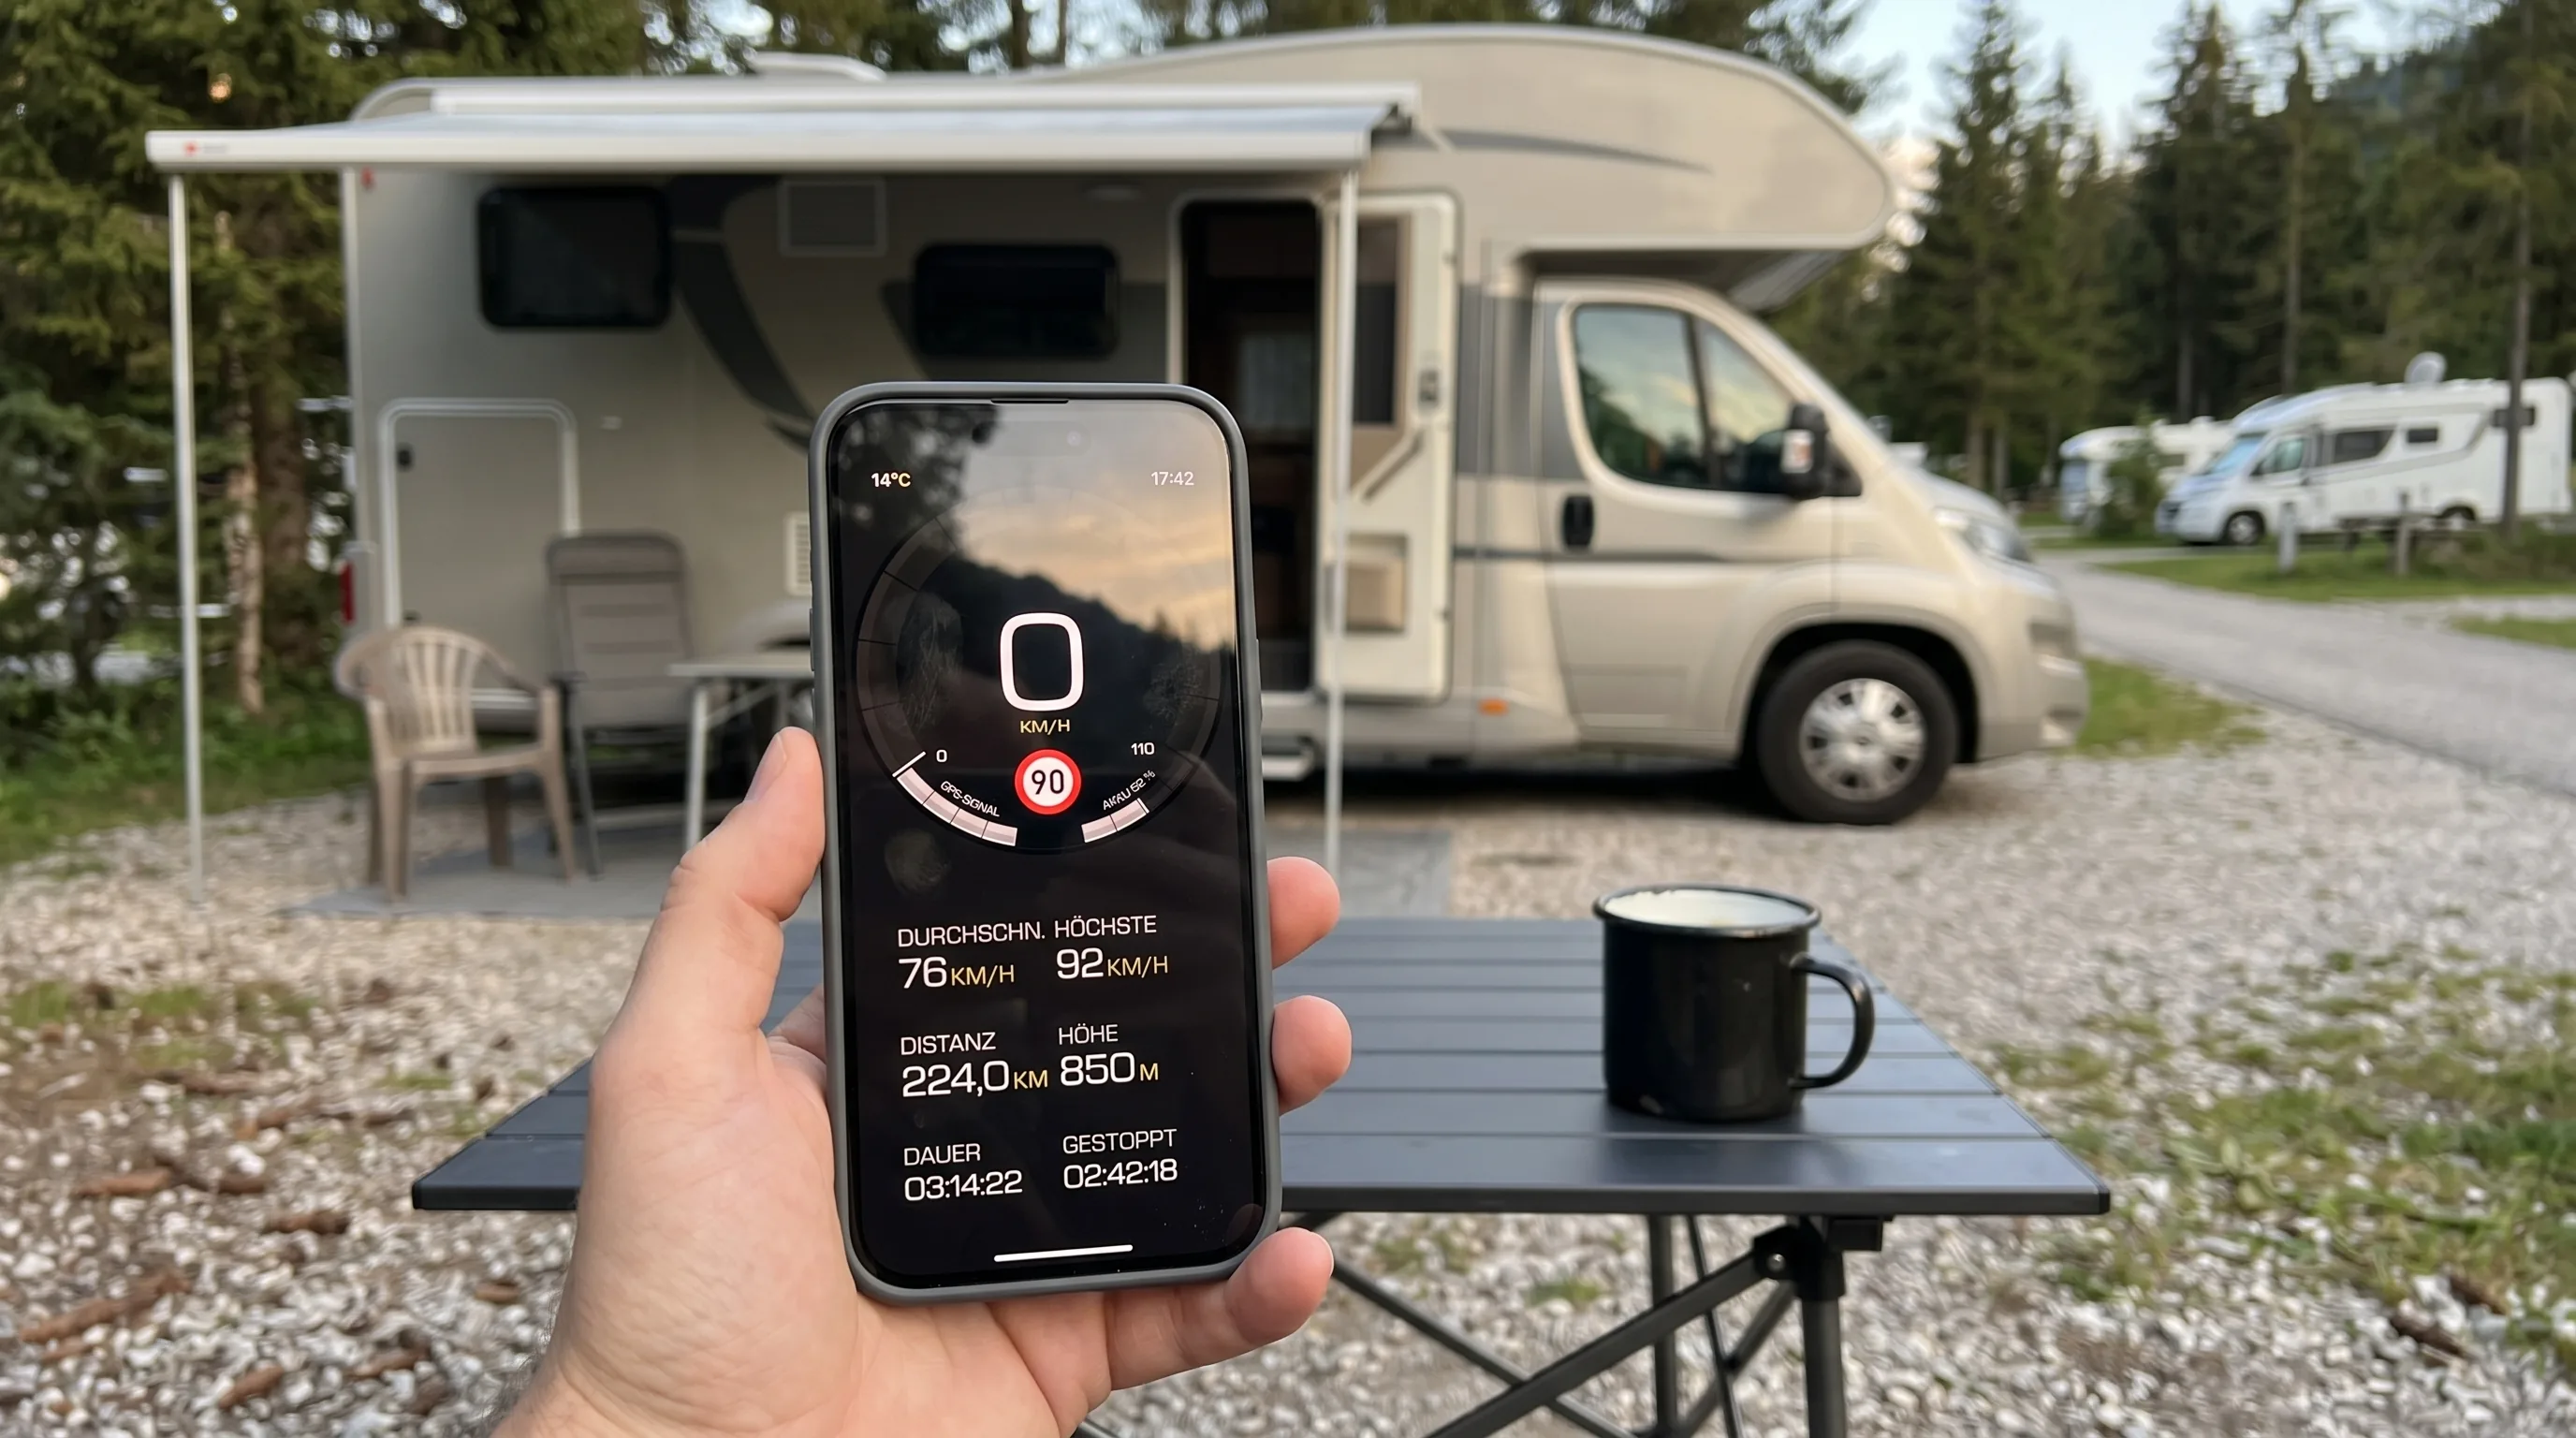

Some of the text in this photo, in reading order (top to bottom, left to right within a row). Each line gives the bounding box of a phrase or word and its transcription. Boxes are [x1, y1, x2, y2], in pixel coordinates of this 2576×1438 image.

[871, 473, 911, 488] 14°C
[1150, 472, 1194, 486] 17:42
[1000, 612, 1084, 712] 0
[1019, 719, 1071, 736] KM/H
[936, 750, 947, 763] 0
[1131, 742, 1155, 756] 110
[1032, 770, 1064, 795] 90
[898, 922, 1046, 947] DURCHSCHN.
[1054, 915, 1157, 938] HÖCHSTE
[898, 956, 1015, 990] 76 KM/H
[1056, 947, 1168, 979] 92 KM/H
[900, 1032, 997, 1056] DISTANZ
[1058, 1023, 1119, 1045] HÖHE
[901, 1060, 1048, 1097] 224,0 KM
[1060, 1051, 1159, 1087] 850 M
[1062, 1129, 1178, 1154] GESTOPPT
[903, 1143, 981, 1167] DAUER
[904, 1169, 1023, 1201] 03:14:22
[1063, 1158, 1178, 1189] 02:42:18
